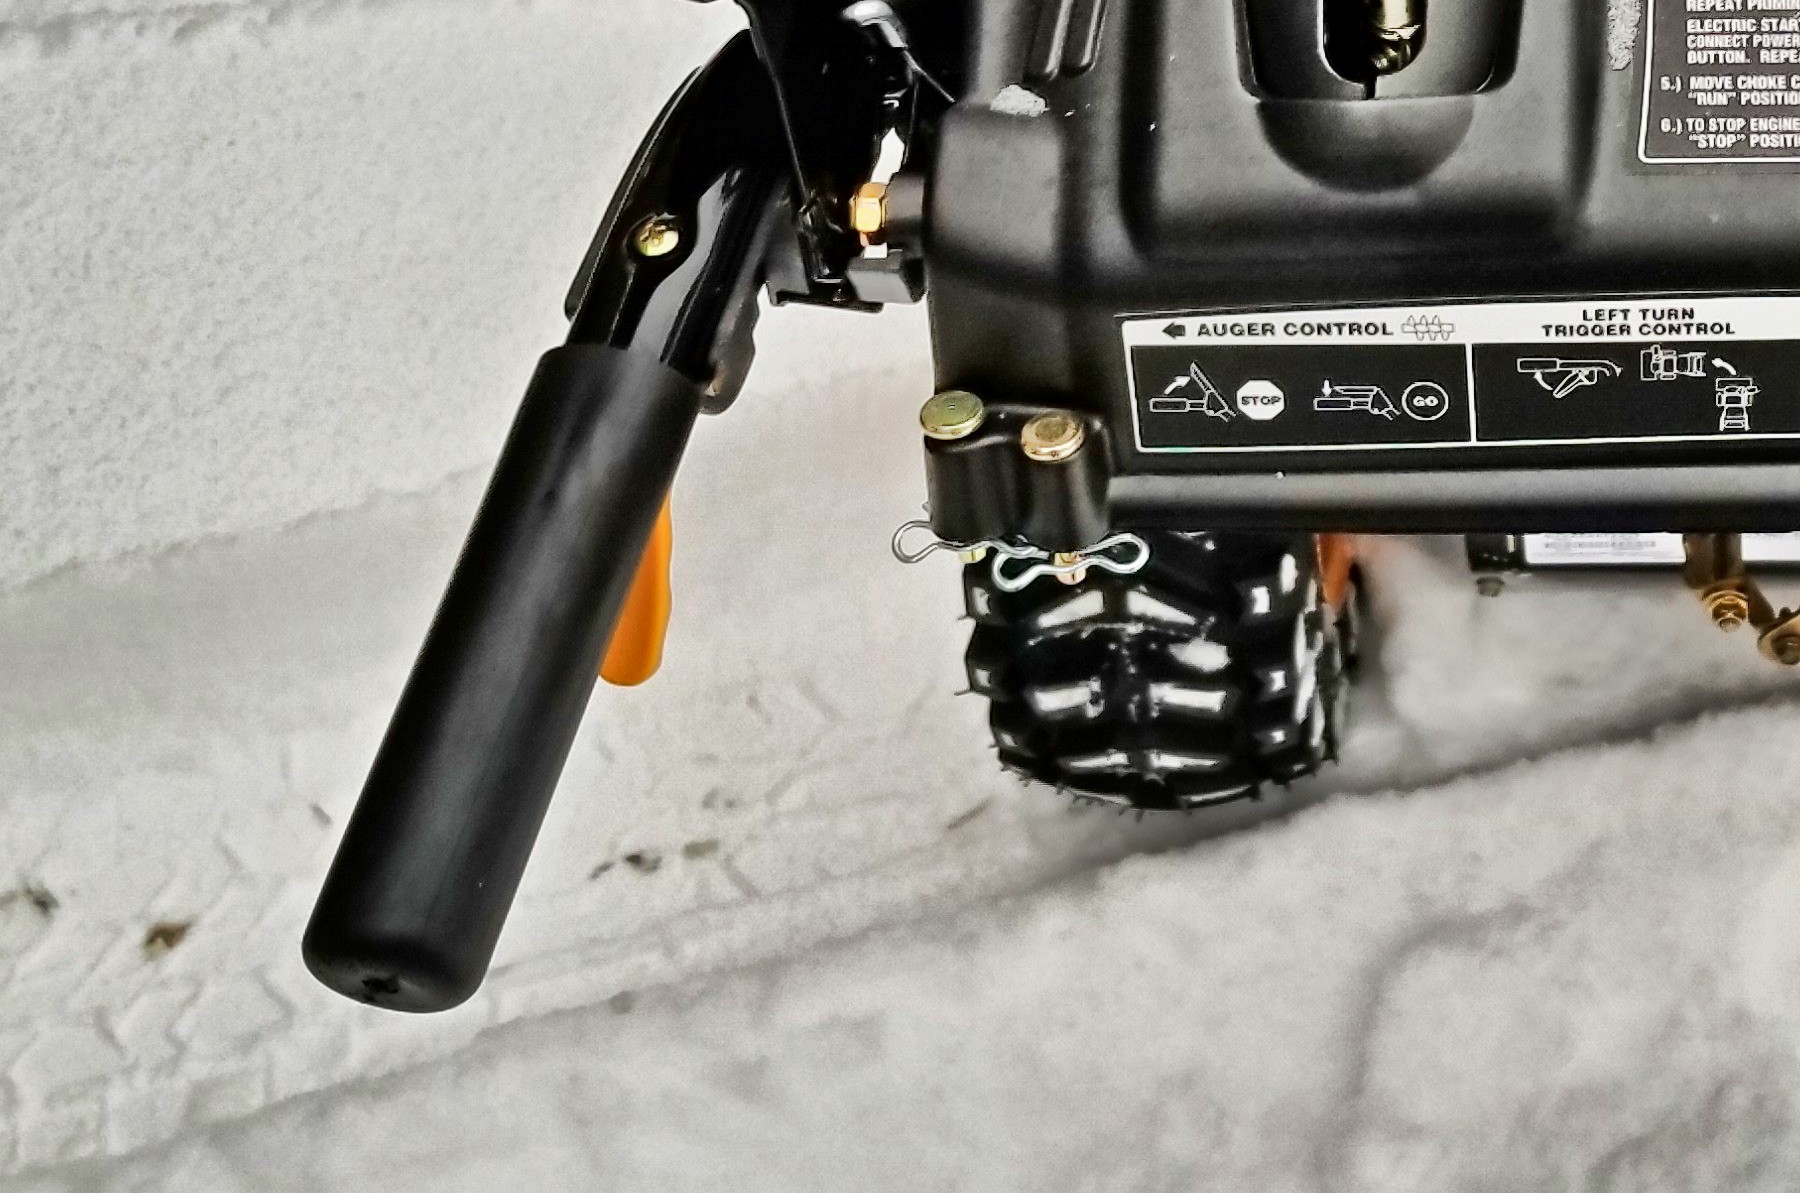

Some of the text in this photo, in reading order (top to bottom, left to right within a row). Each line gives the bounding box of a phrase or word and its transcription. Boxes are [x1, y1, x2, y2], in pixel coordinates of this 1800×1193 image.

[1686, 18, 1757, 33] ELECTRIC
[1687, 34, 1751, 49] CONNECT
[1753, 34, 1800, 48] POWER
[1687, 50, 1751, 65] BUTTON.
[1660, 76, 1682, 93] 5.)
[1689, 76, 1734, 91] MOVE
[1737, 75, 1787, 90] CHOKE
[1660, 117, 1683, 135] 6.)
[1686, 117, 1705, 132] TO
[1709, 117, 1747, 132] STOP
[1583, 307, 1695, 322] LEFT TURN
[1197, 321, 1393, 337] AUGER CONTROL
[1542, 322, 1735, 337] TRIGGER CONTROL
[1241, 393, 1282, 406] STOP
[1412, 396, 1439, 407] GO
